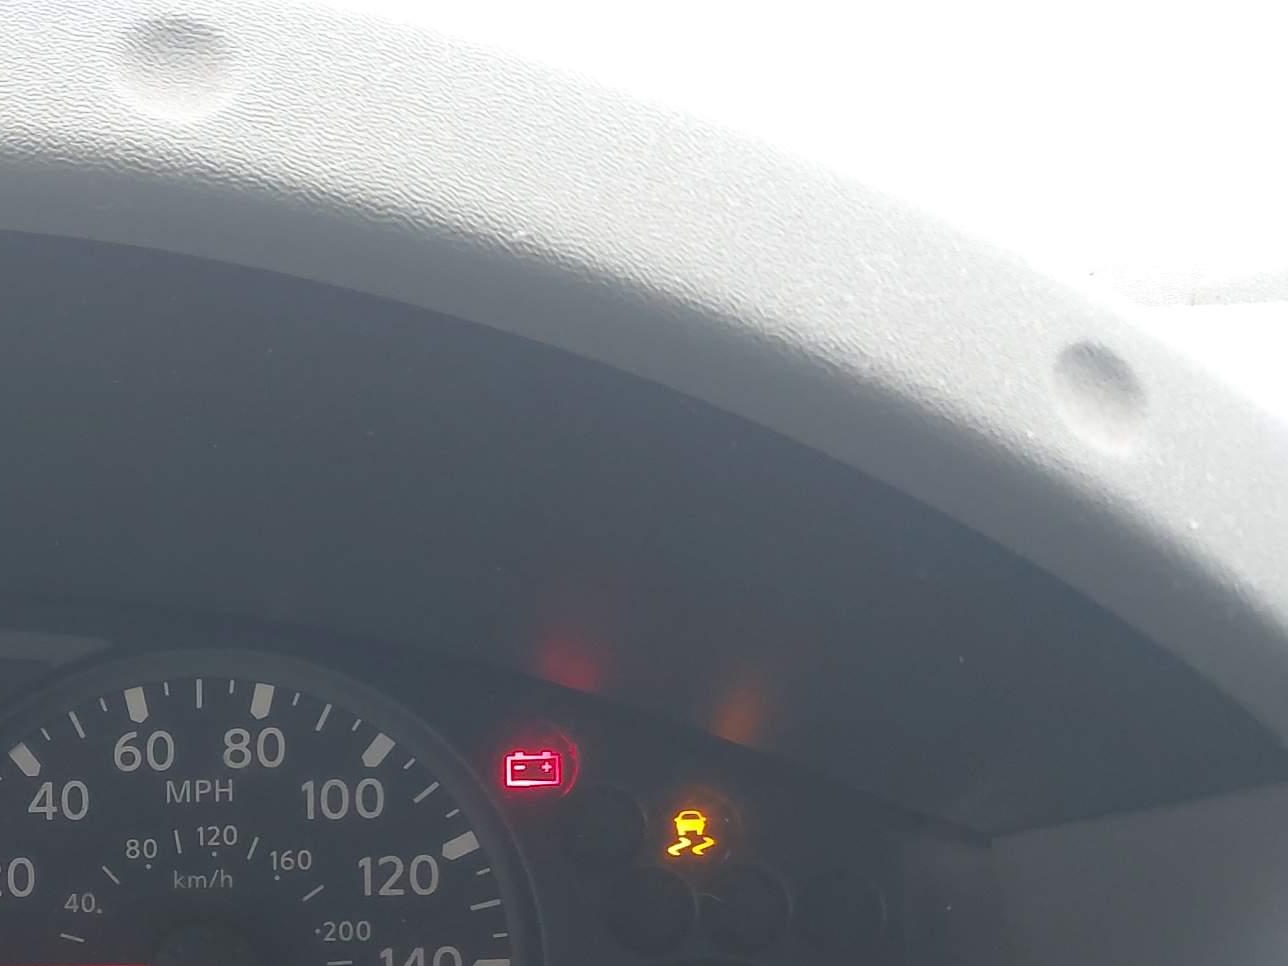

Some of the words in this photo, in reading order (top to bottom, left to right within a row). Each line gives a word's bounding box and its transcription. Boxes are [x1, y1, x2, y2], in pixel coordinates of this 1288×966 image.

[114, 730, 175, 772] 60
[223, 727, 286, 769] 80
[27, 781, 90, 821] 40
[166, 779, 234, 804] MPH
[301, 778, 385, 820] 100
[197, 825, 238, 847] 120
[125, 838, 158, 860] 80
[270, 849, 312, 871] 160
[173, 868, 234, 889] km/h
[359, 855, 439, 896] 120
[63, 893, 96, 913] 40
[323, 920, 371, 942] 200
